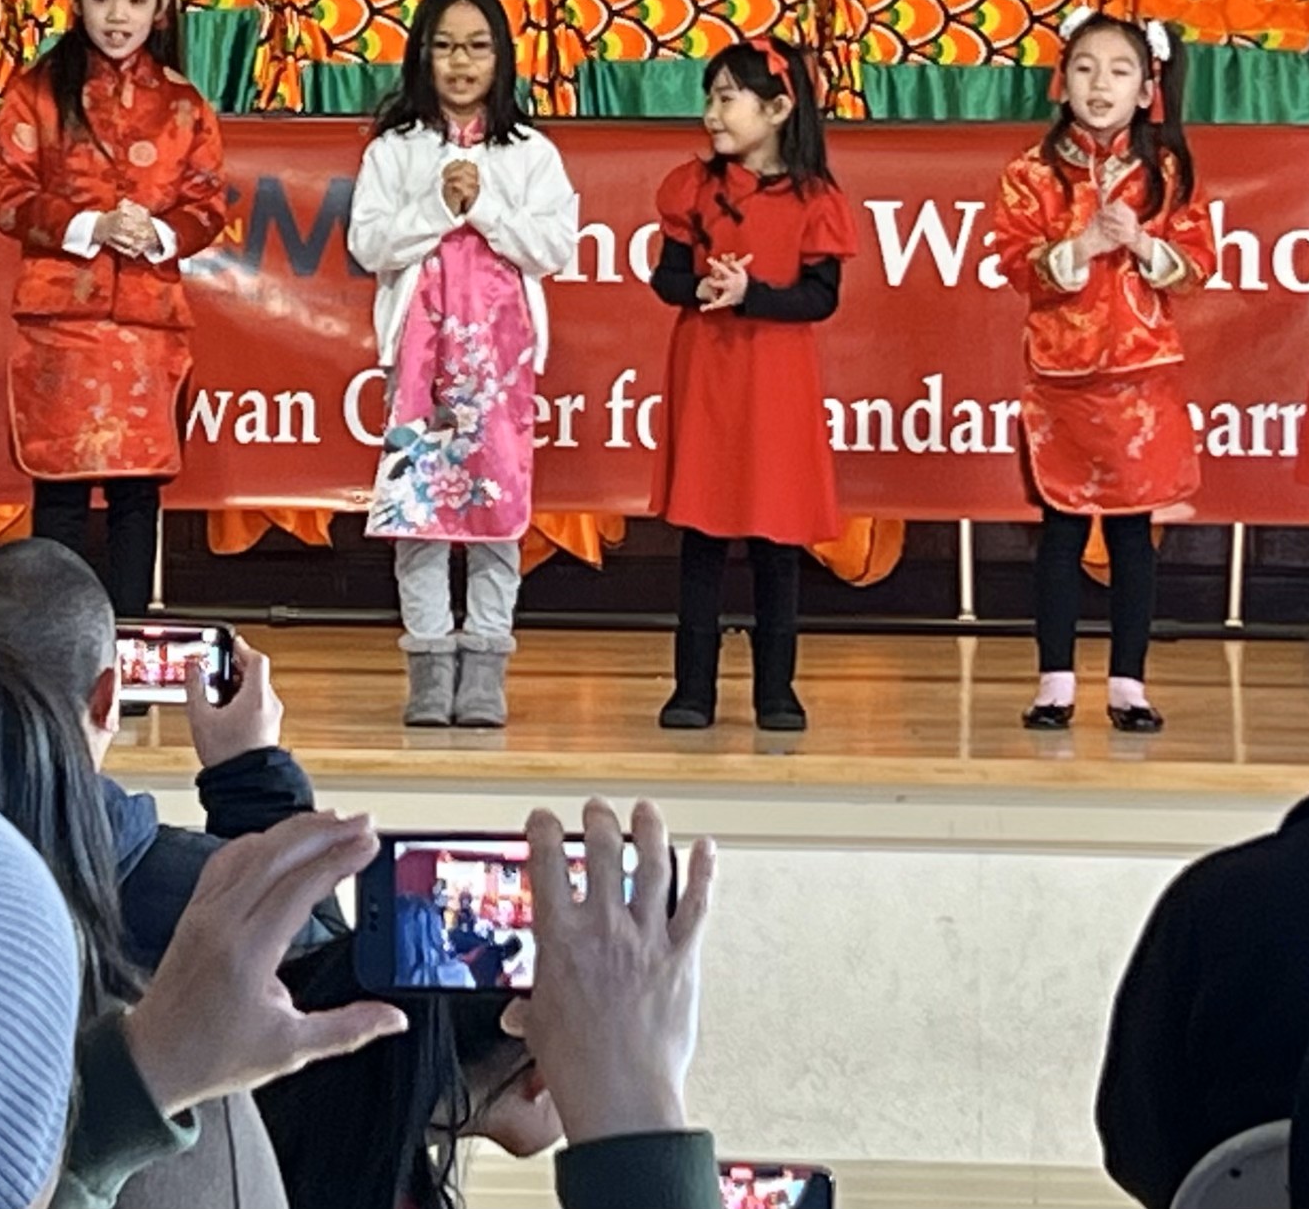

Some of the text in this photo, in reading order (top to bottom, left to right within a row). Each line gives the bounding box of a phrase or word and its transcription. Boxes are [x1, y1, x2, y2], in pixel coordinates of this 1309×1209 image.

[185, 389, 322, 444] wan
[604, 368, 662, 450] fo
[823, 373, 1021, 454] andar
